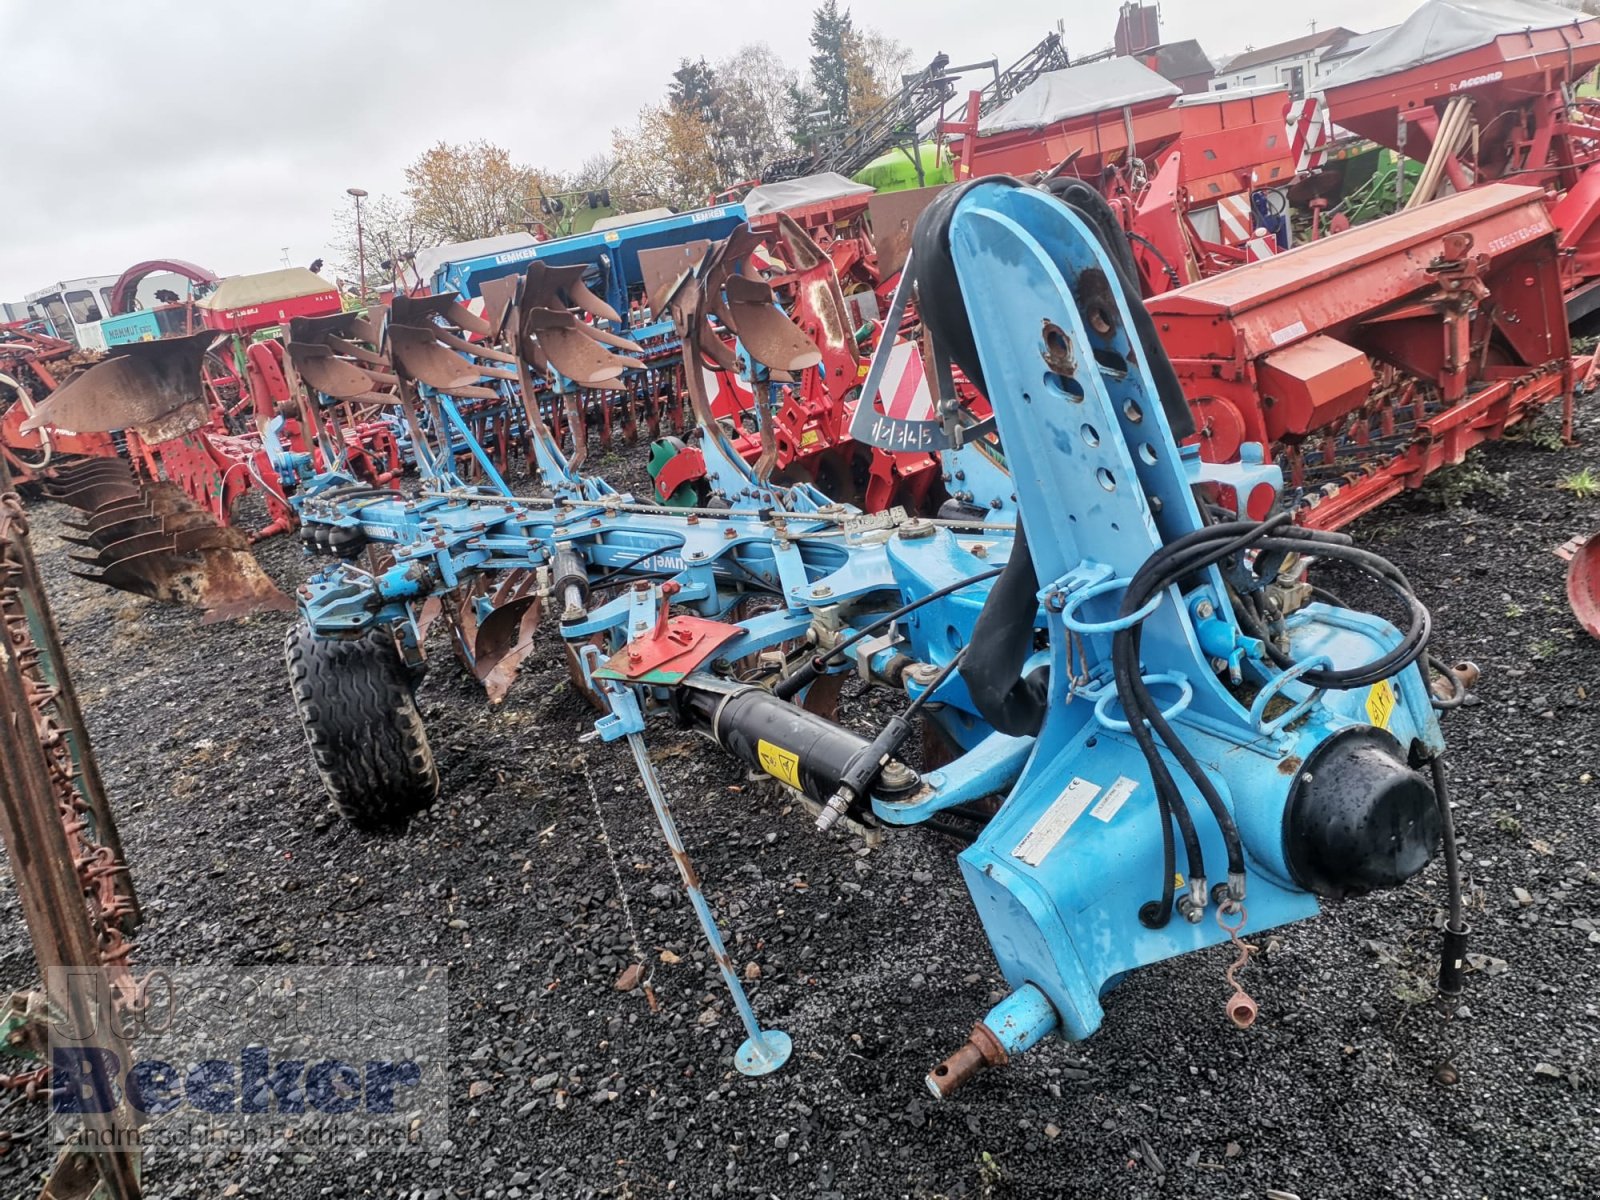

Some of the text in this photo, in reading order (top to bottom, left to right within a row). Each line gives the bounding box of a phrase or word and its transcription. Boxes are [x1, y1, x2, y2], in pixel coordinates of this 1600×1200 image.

[1458, 71, 1503, 90] ACCORD
[692, 208, 726, 224] LEMKEN
[495, 248, 537, 265] LEMKEN
